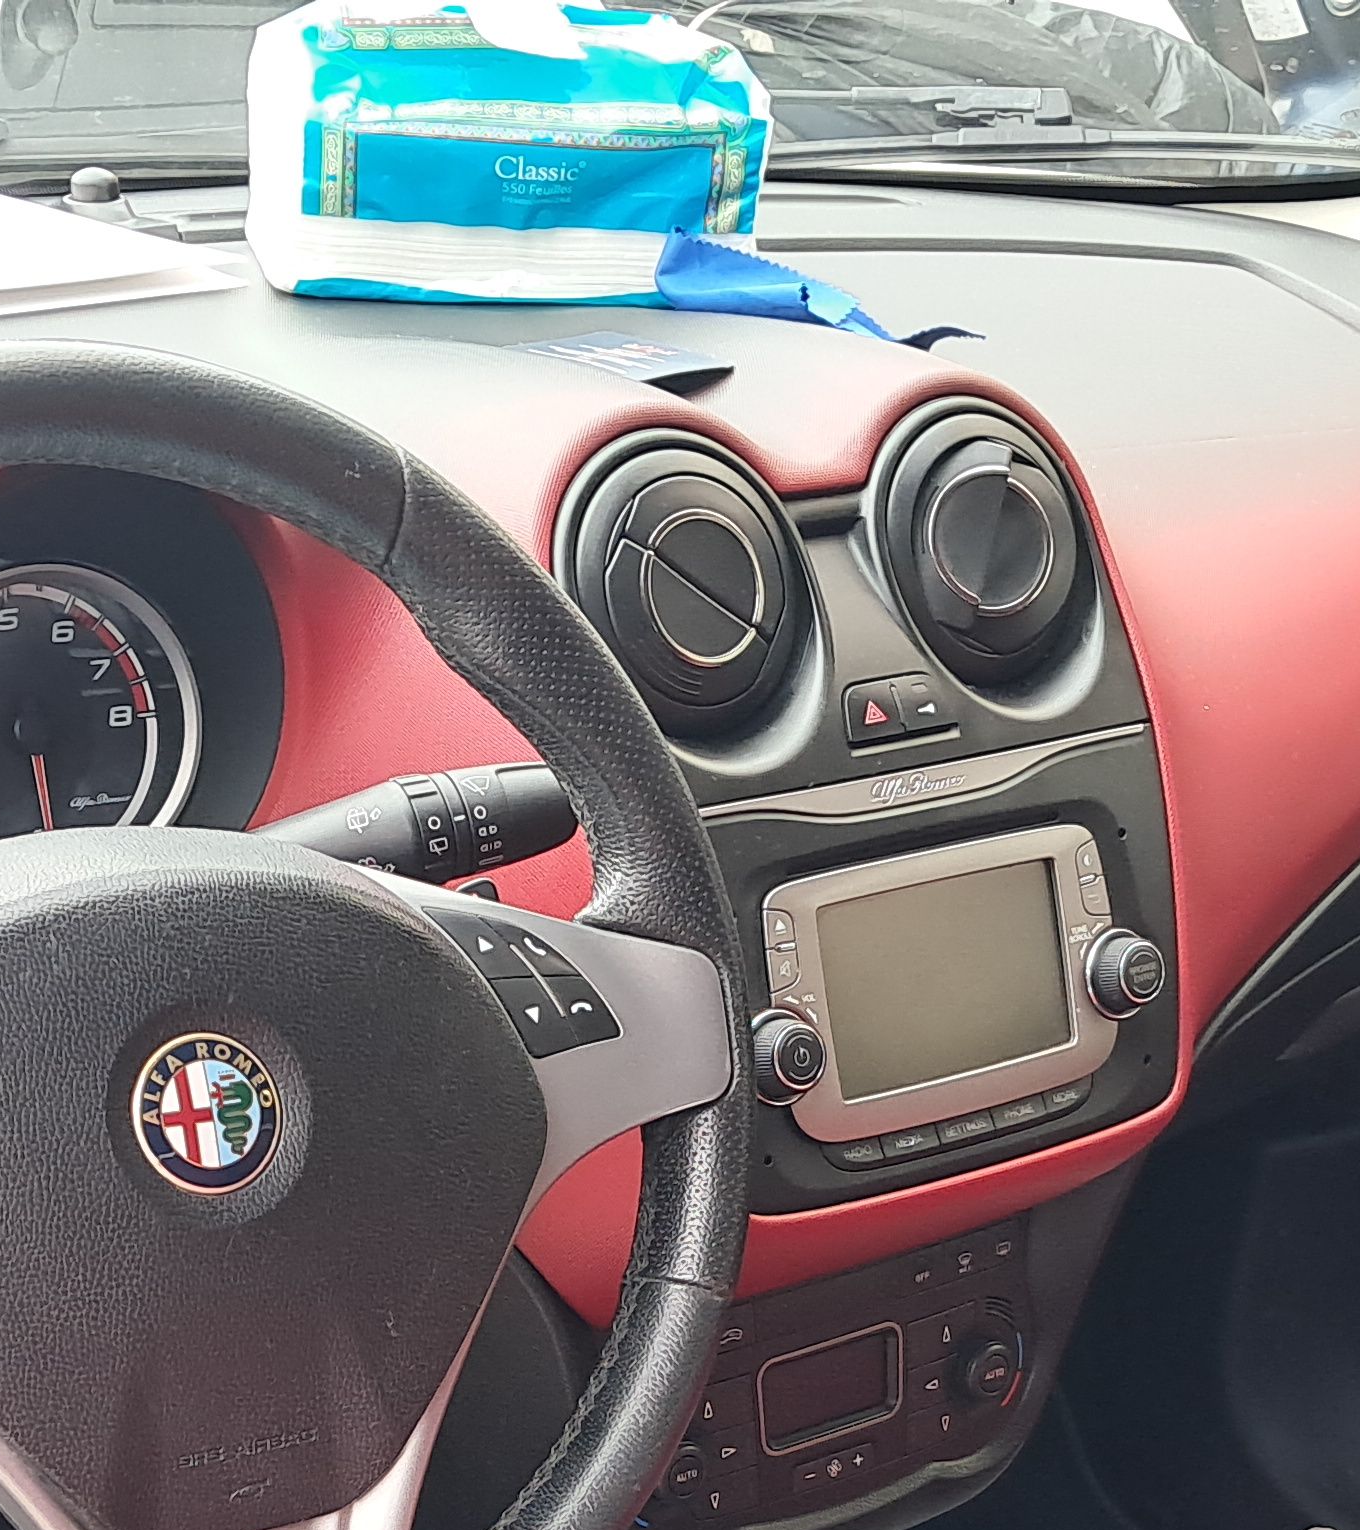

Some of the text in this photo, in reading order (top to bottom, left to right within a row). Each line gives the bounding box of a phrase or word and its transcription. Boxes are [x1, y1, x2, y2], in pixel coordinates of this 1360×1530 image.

[502, 182, 526, 195] 550
[51, 620, 75, 643] 6
[89, 658, 111, 681] 7
[108, 705, 133, 727] 8
[143, 1053, 183, 1125] ALFA
[843, 1144, 872, 1161] RADIO
[676, 1469, 698, 1482] AUTO
